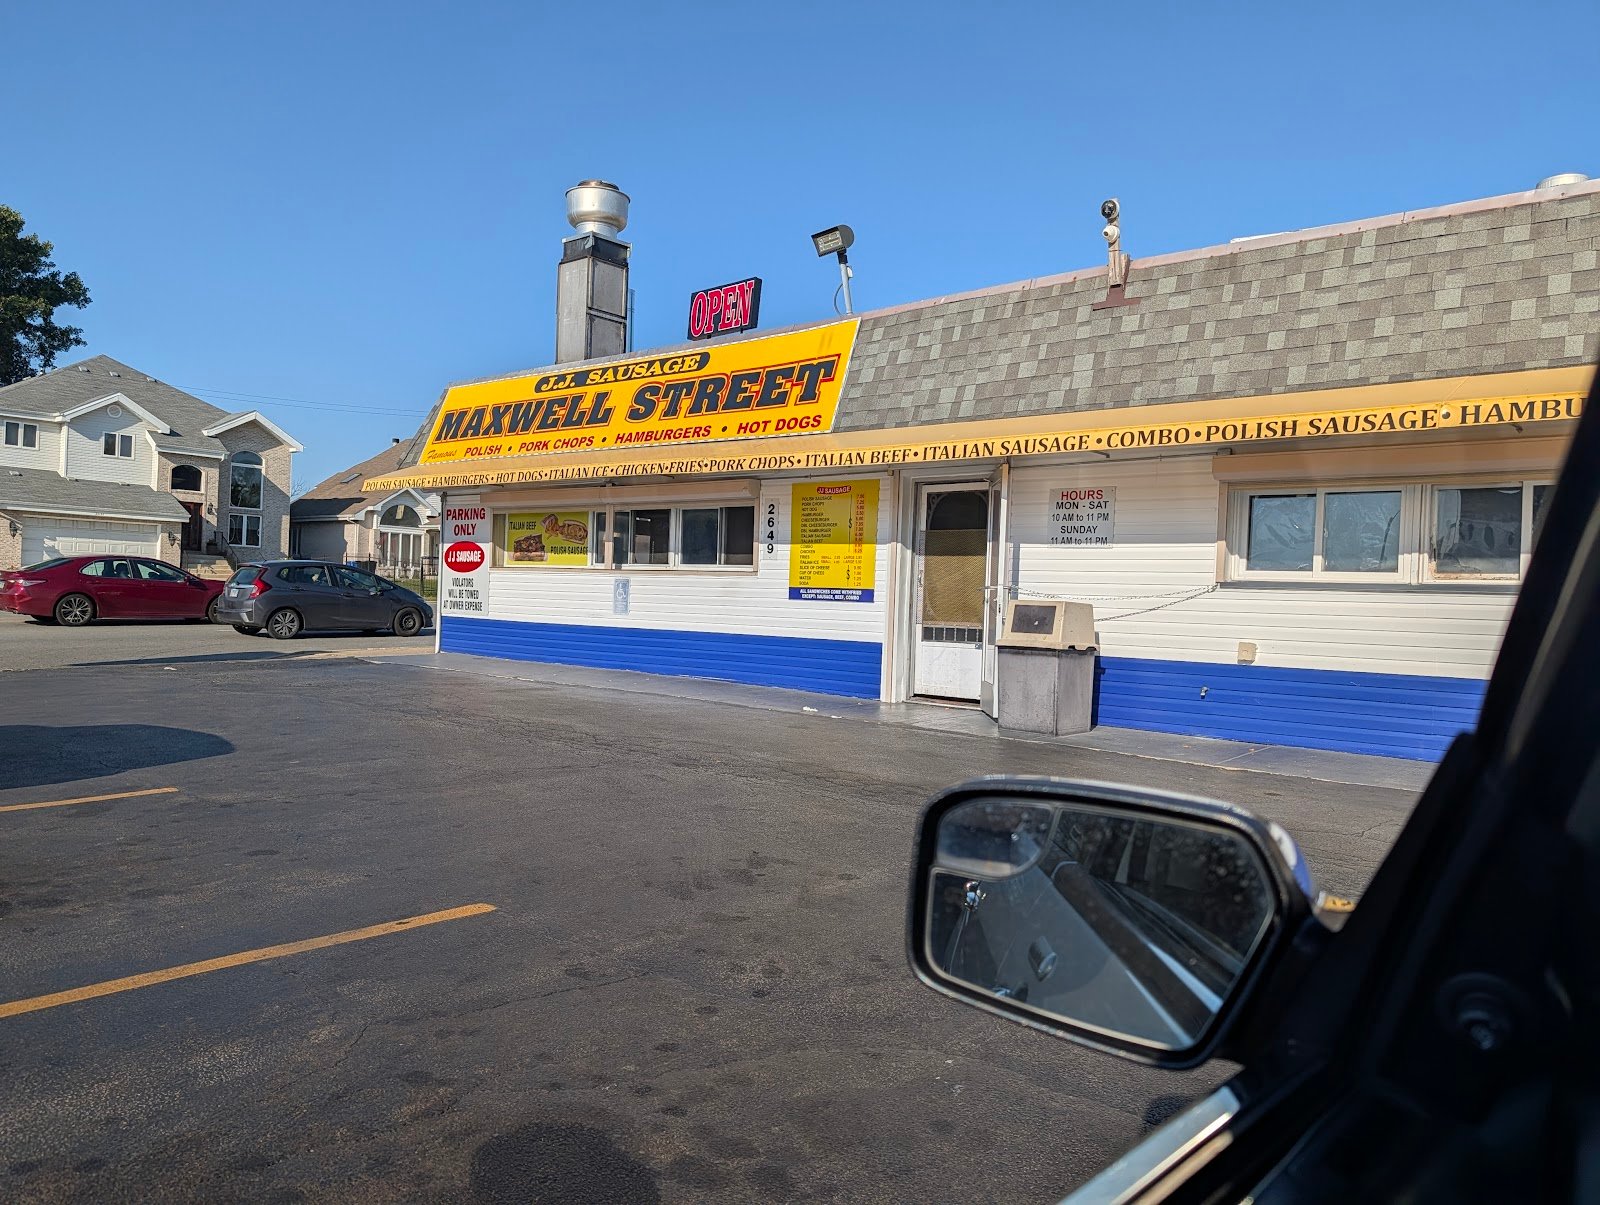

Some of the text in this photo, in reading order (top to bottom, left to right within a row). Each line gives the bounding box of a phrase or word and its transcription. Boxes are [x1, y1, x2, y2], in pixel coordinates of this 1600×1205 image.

[690, 280, 755, 337] OPEN
[540, 354, 701, 392] J.J. SAUSAGE
[433, 354, 841, 444] MAXWELL STREET
[464, 414, 822, 457] POLISH PORK CHOPS HAMBURGERS HOT DOGS
[364, 480, 392, 490] POLISH
[393, 477, 426, 489] SAUSAGE
[431, 475, 489, 487] HAMBURGERS
[496, 472, 516, 483] HOT
[517, 470, 544, 482] DOGS
[549, 466, 590, 480] ITALIAN
[590, 465, 610, 478] ICE
[615, 462, 665, 476] CHICKEN
[670, 460, 704, 474] FRIES
[709, 458, 747, 472] PORK
[748, 455, 794, 470] CHOPS
[805, 450, 866, 468] ITALIAN
[870, 448, 912, 464] BEEF
[922, 442, 995, 461] ITALIAN
[1000, 434, 1090, 456] SAUSAGE
[1106, 427, 1190, 448] COMBO
[1205, 420, 1298, 442] POLISH
[1307, 409, 1438, 436] SAUSAGE
[424, 449, 457, 462] Famous
[1061, 490, 1103, 500] HOURS
[1088, 501, 1109, 509] SAT
[446, 508, 486, 520] PARKING
[1097, 513, 1109, 521] PM
[454, 524, 476, 536] ONLY
[509, 522, 536, 530] ITALIAN BEEF
[456, 550, 481, 562] SAUSAGE
[551, 546, 588, 555] POLISH SAUSAGE
[452, 578, 474, 587] VIOLATORS
[448, 589, 479, 599] WILL BE TOWED
[443, 600, 482, 611] AT OWNER EXPENSE
